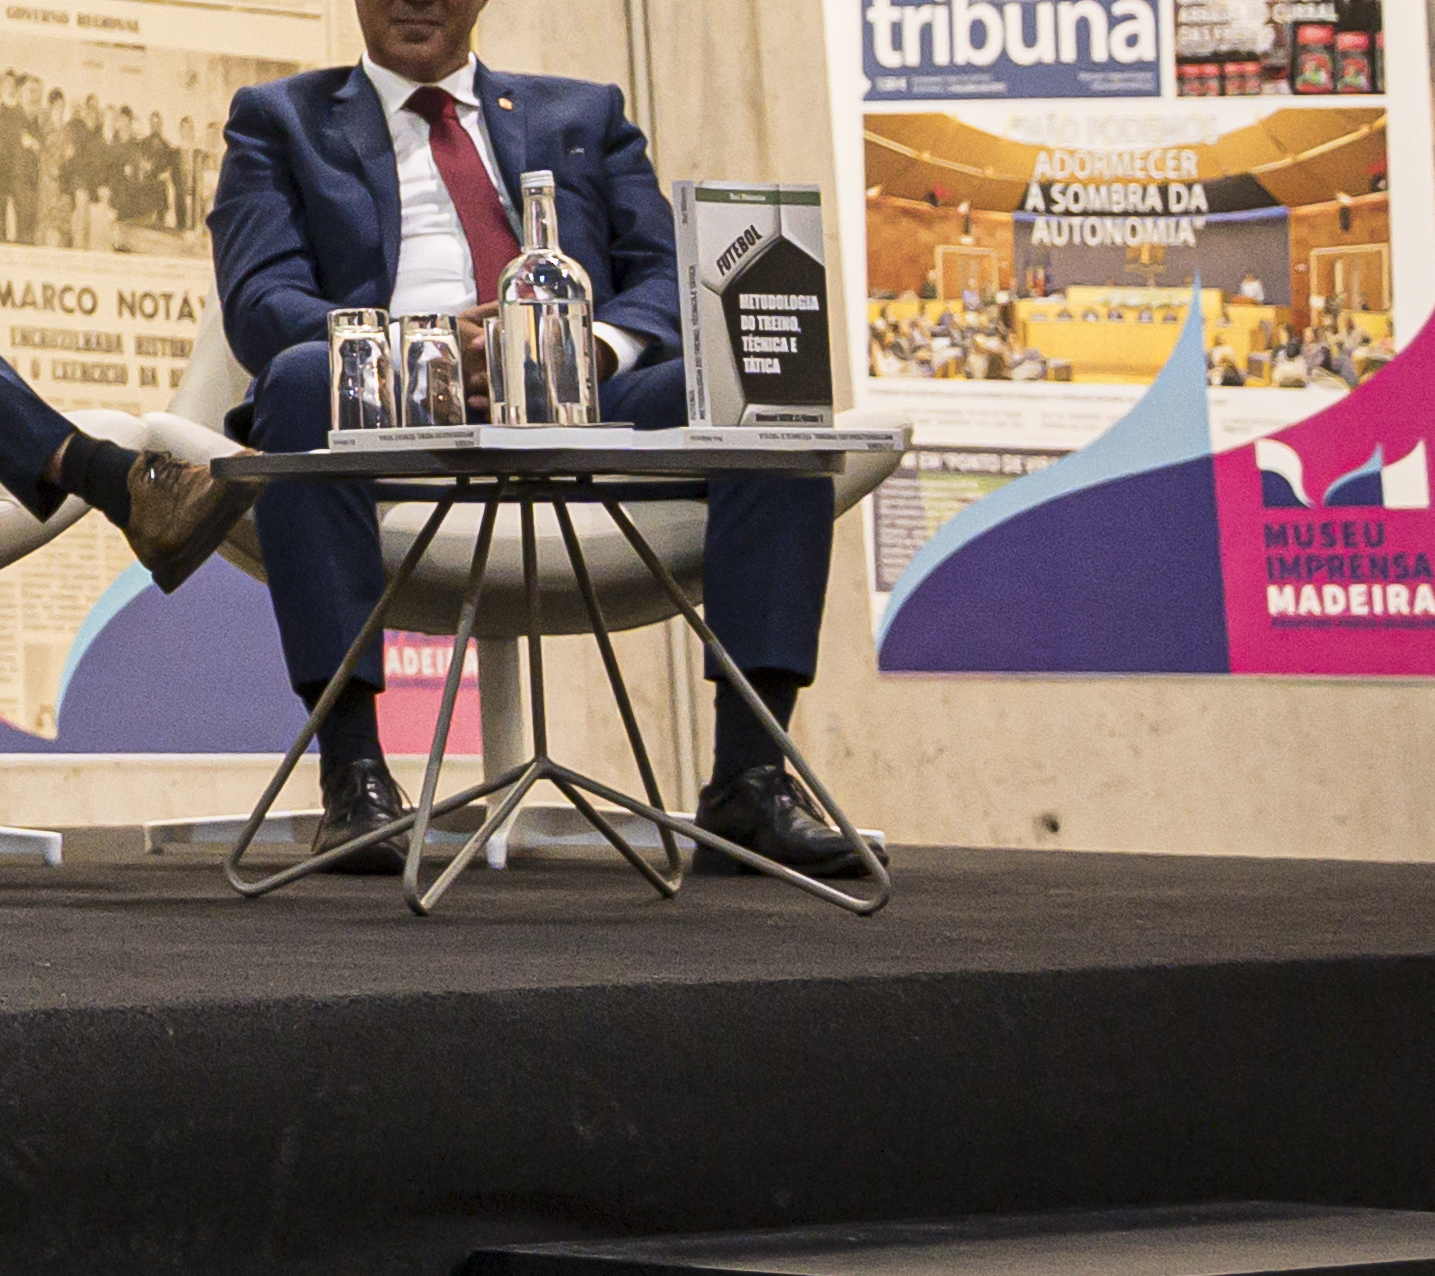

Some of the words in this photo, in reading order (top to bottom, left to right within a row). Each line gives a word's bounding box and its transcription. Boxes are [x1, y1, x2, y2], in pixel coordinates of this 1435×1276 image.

[1034, 150, 1200, 180] ADORMECER
[1050, 183, 1165, 214] SOMBRA
[1168, 182, 1210, 213] DA
[716, 224, 763, 277] FUTEBOL
[739, 294, 820, 311] METODOLOGIA
[1263, 521, 1386, 550] MUSEU
[1266, 552, 1435, 582] IMPRENSA
[1267, 584, 1435, 617] MADEIRA
